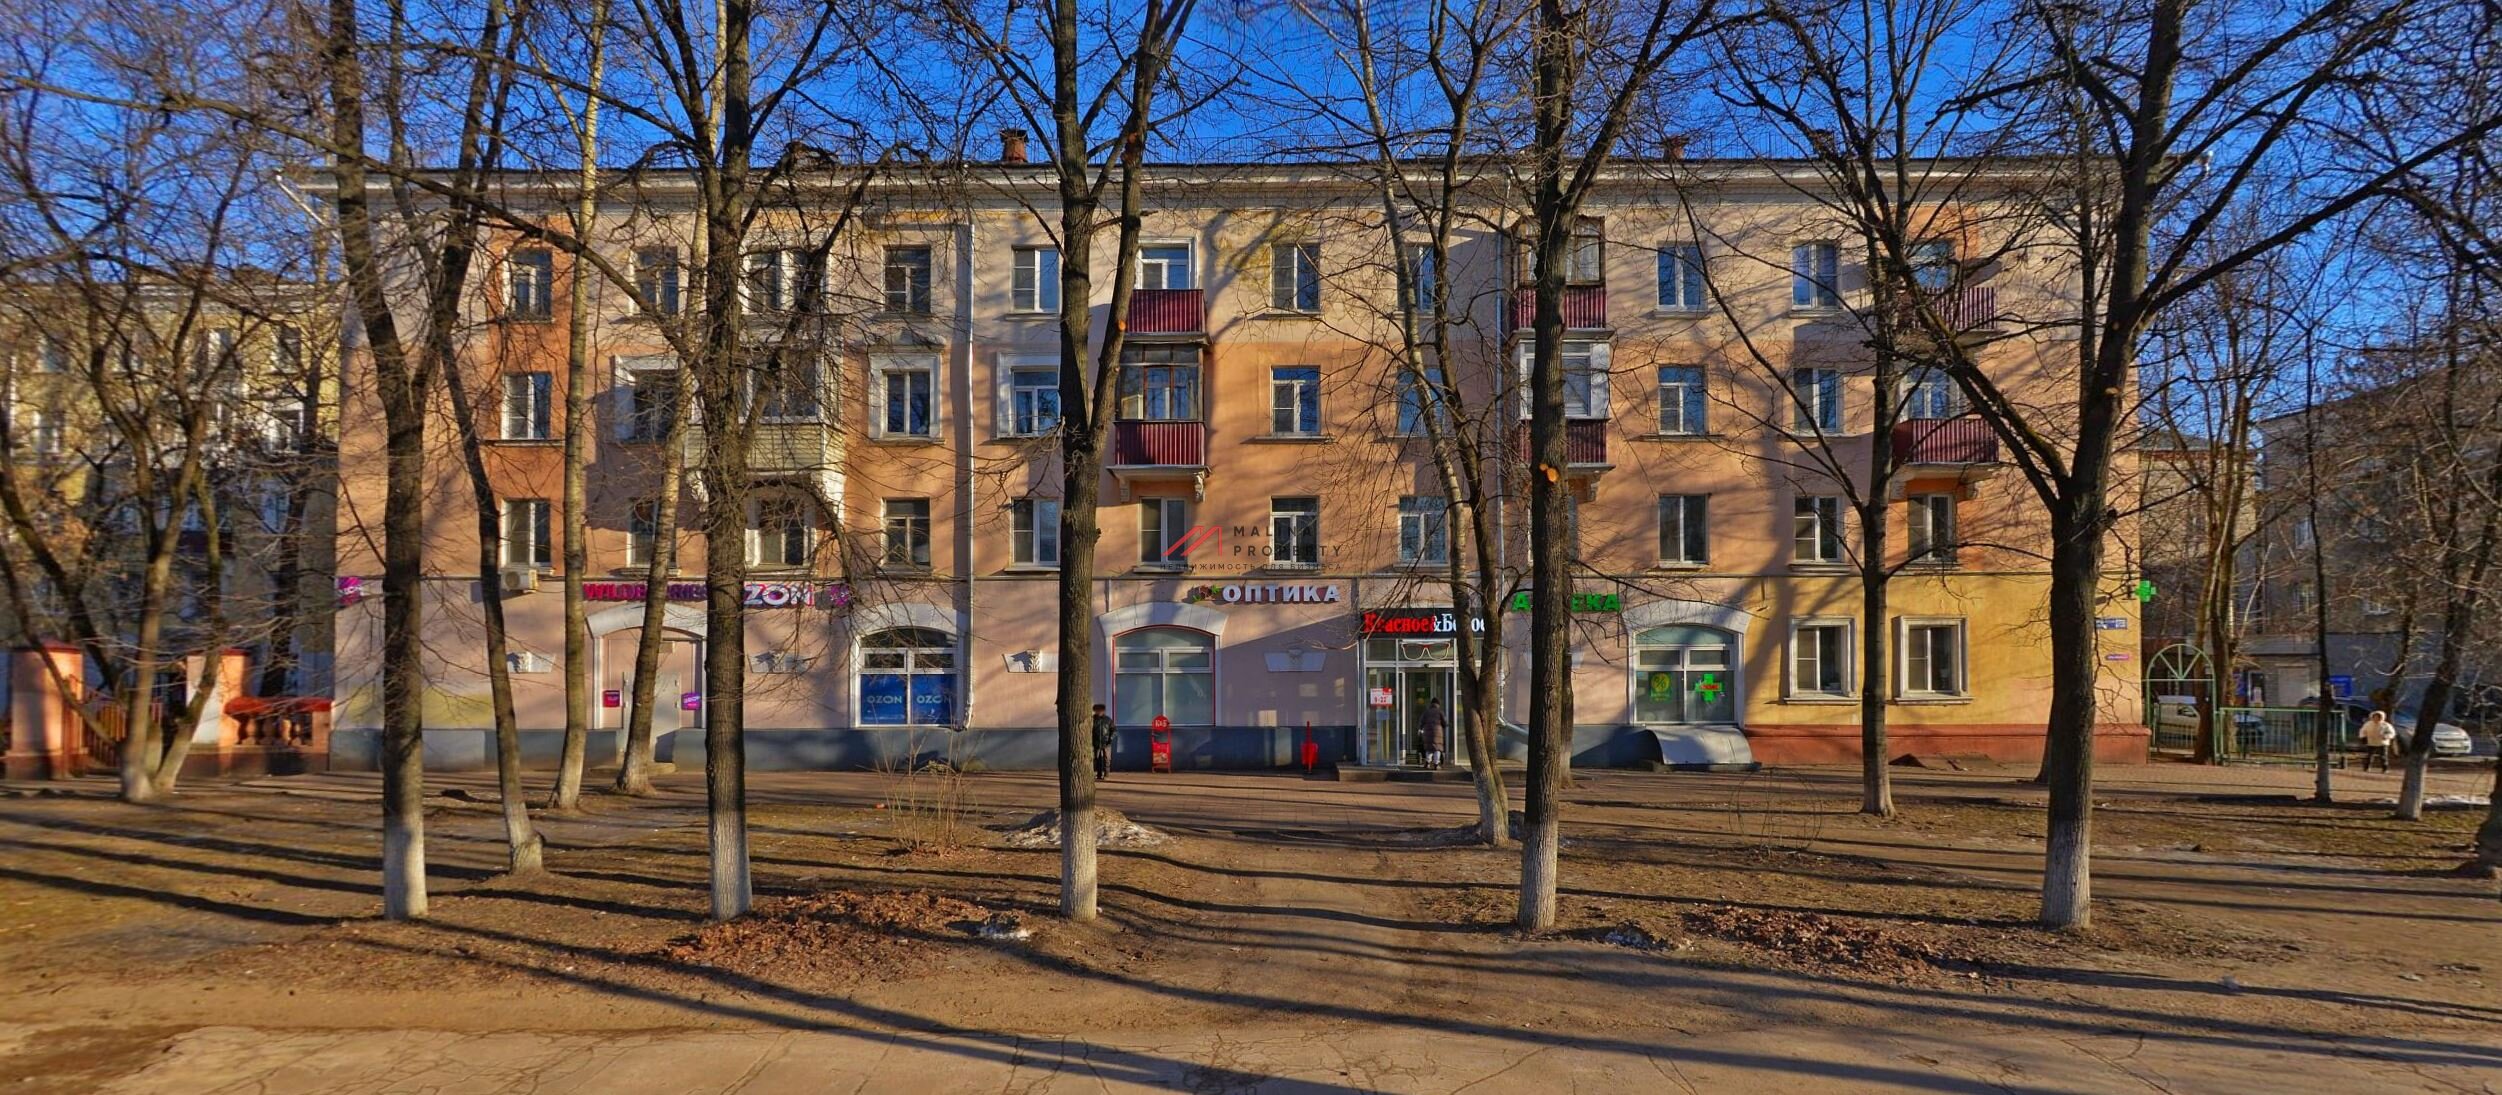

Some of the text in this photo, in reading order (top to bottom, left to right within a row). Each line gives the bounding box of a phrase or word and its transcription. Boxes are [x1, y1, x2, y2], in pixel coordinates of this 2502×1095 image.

[1222, 584, 1341, 602] ОПТИКА
[1511, 593, 1621, 613] АЕКА
[866, 695, 903, 704] OZON
